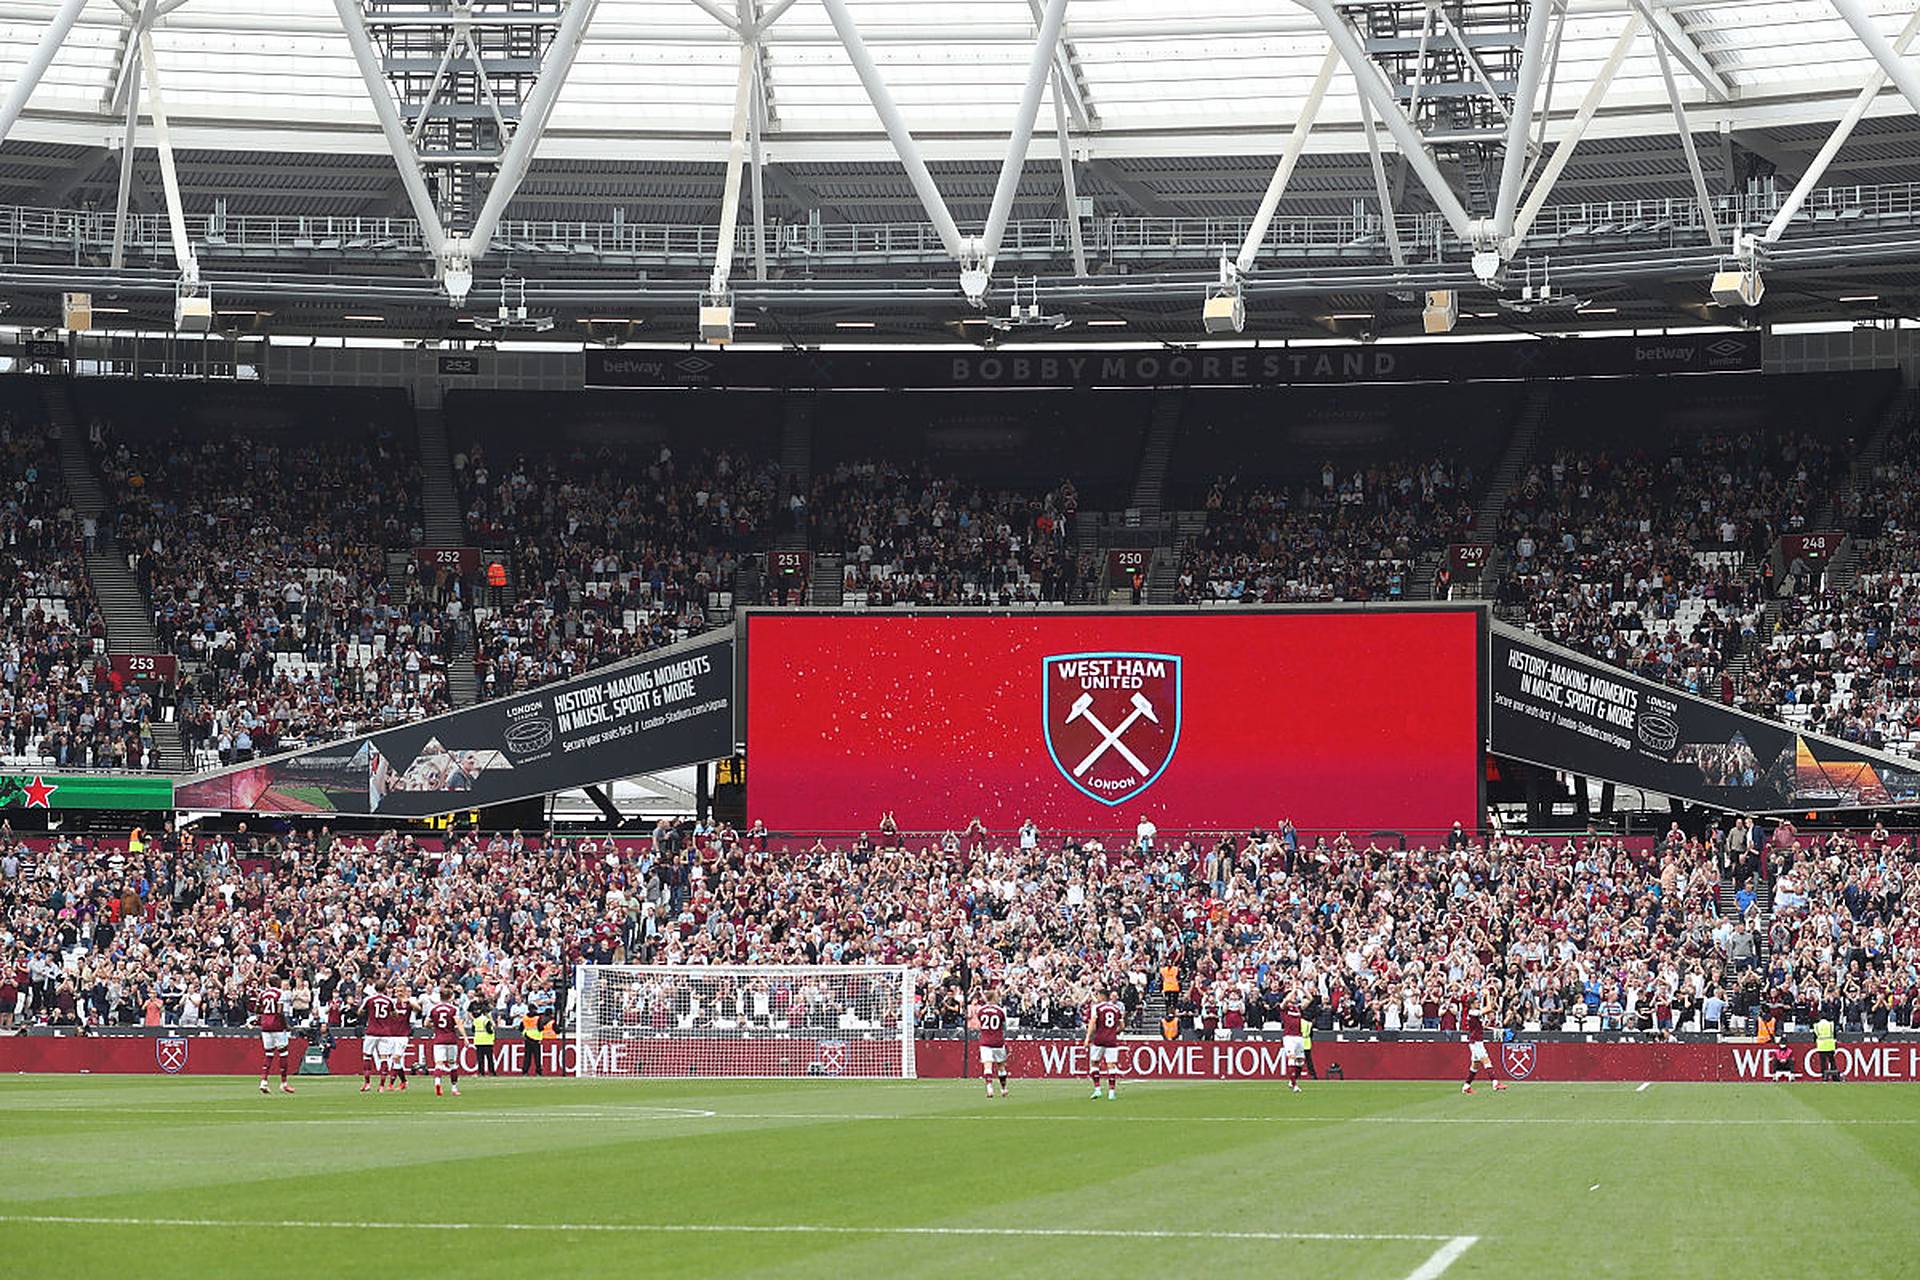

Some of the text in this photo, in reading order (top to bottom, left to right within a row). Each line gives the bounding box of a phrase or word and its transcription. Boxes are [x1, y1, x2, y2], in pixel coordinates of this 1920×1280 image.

[1635, 346, 1695, 361] betway
[446, 360, 471, 371] 252
[603, 360, 663, 377] betway
[952, 352, 1396, 380] BOBBY MOORE STAND
[1802, 537, 1825, 549] 248
[436, 551, 460, 562] 252
[778, 554, 801, 566] 251
[1119, 553, 1142, 564] 250
[1460, 547, 1483, 559] 249
[129, 657, 154, 670] 253
[1058, 660, 1166, 679] WEST HAM
[554, 655, 711, 714] HISTORY-MAKING MOMENTS
[1081, 676, 1143, 689] UNITED
[1508, 649, 1638, 709] HISTORY-MAKING MOMENTS
[557, 679, 697, 733] IN MUSIC, SPORT & MORE
[1520, 674, 1531, 694] IN
[1531, 678, 1564, 708] MUSIC,
[1565, 690, 1598, 716] SPORT
[1597, 702, 1607, 719] &
[1606, 707, 1636, 730] MORE
[1087, 776, 1136, 790] LONDON
[262, 998, 276, 1014] 21
[374, 1003, 388, 1019] 15
[438, 1012, 448, 1028] 5
[980, 1015, 1000, 1030] 20
[1105, 1012, 1115, 1028] 8
[1213, 1046, 1307, 1076] HOM
